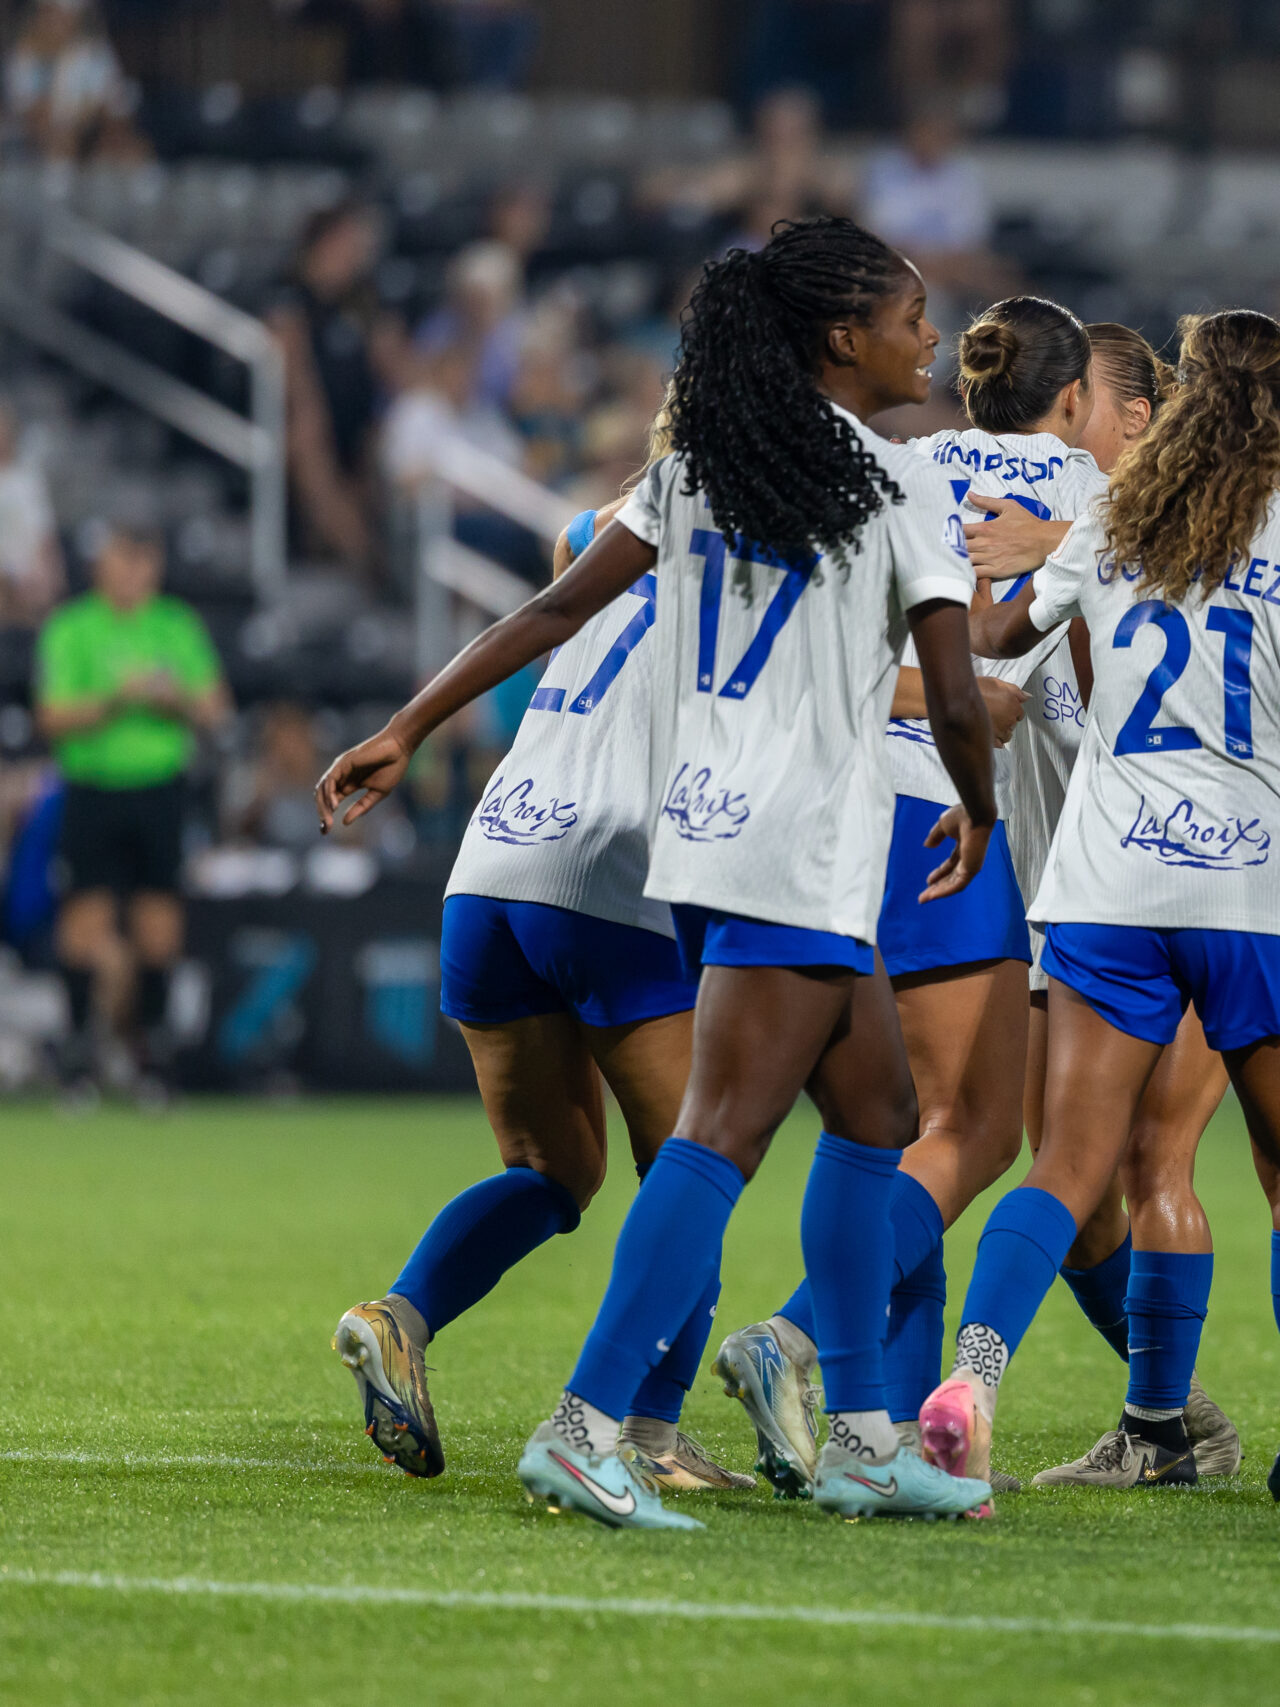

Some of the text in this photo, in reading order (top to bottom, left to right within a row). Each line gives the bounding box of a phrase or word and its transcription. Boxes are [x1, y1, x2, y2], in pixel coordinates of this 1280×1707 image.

[933, 441, 1064, 485] IMPSON
[689, 528, 824, 701] 17
[1112, 599, 1255, 760] 21
[473, 776, 577, 845] LaCroix
[1120, 794, 1271, 869] LaCroix
